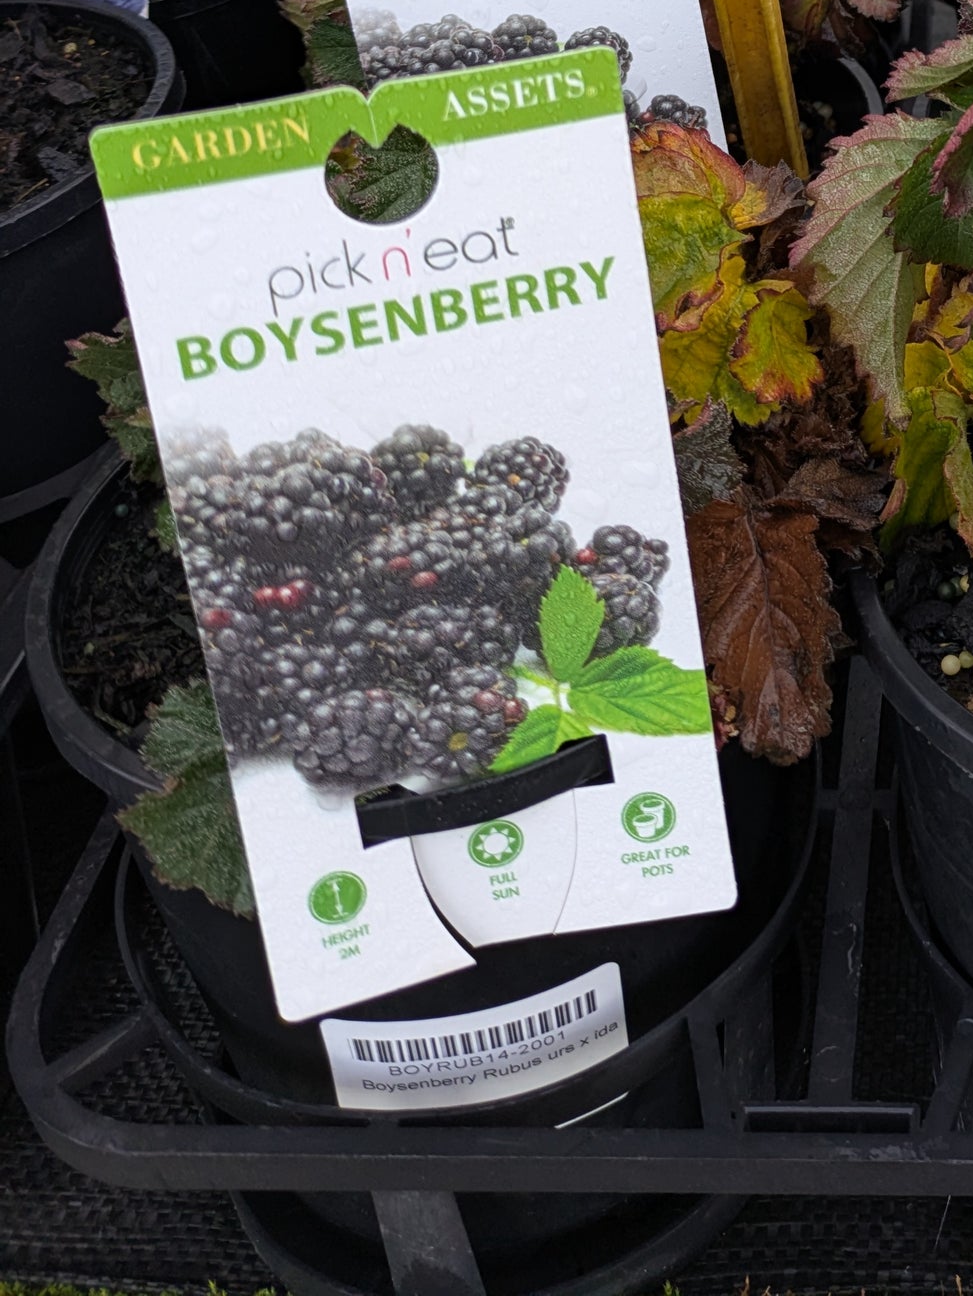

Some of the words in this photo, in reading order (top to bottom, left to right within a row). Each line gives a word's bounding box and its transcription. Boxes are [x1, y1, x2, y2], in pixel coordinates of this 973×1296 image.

[131, 114, 311, 170] GARDEN
[441, 68, 587, 122] ASSETS
[267, 239, 373, 316] pick
[423, 216, 519, 271] eat
[175, 255, 617, 382] BOYSENBERRY
[620, 848, 662, 865] GREAT
[665, 845, 691, 860] FOR
[489, 871, 518, 886] FULL
[641, 863, 675, 878] POTS
[492, 886, 521, 901] SUN
[322, 923, 371, 950] HEIGHT
[339, 944, 362, 960] 2M
[362, 1074, 477, 1094] Boysenberry
[483, 1057, 543, 1080] Rubus
[547, 1044, 576, 1061] urs
[580, 1038, 591, 1049] x
[594, 1020, 620, 1041] ida
[388, 1030, 567, 1077] BOYRUB14-2001
